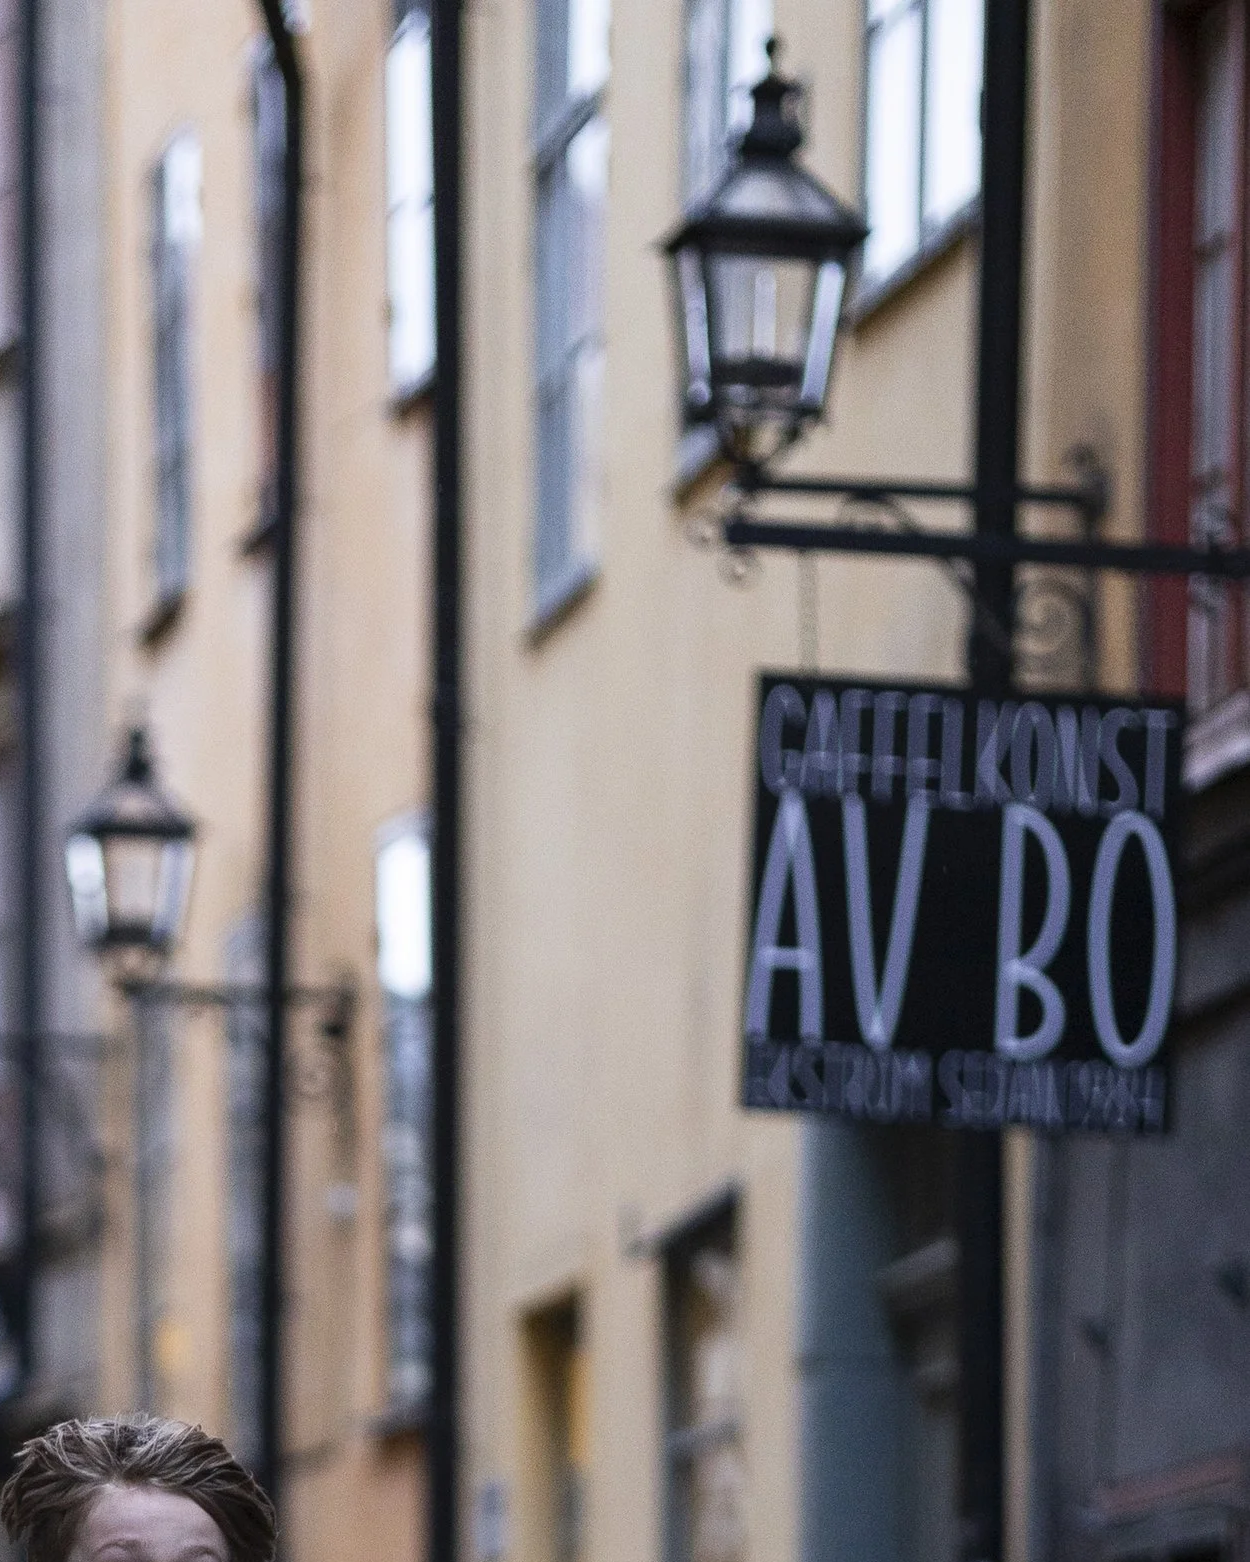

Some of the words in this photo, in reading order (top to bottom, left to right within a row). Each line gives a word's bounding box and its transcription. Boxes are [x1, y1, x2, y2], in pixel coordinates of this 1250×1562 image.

[760, 684, 1178, 822] GAFFELKONST
[745, 787, 932, 1053] AV
[994, 801, 1178, 1070] BO
